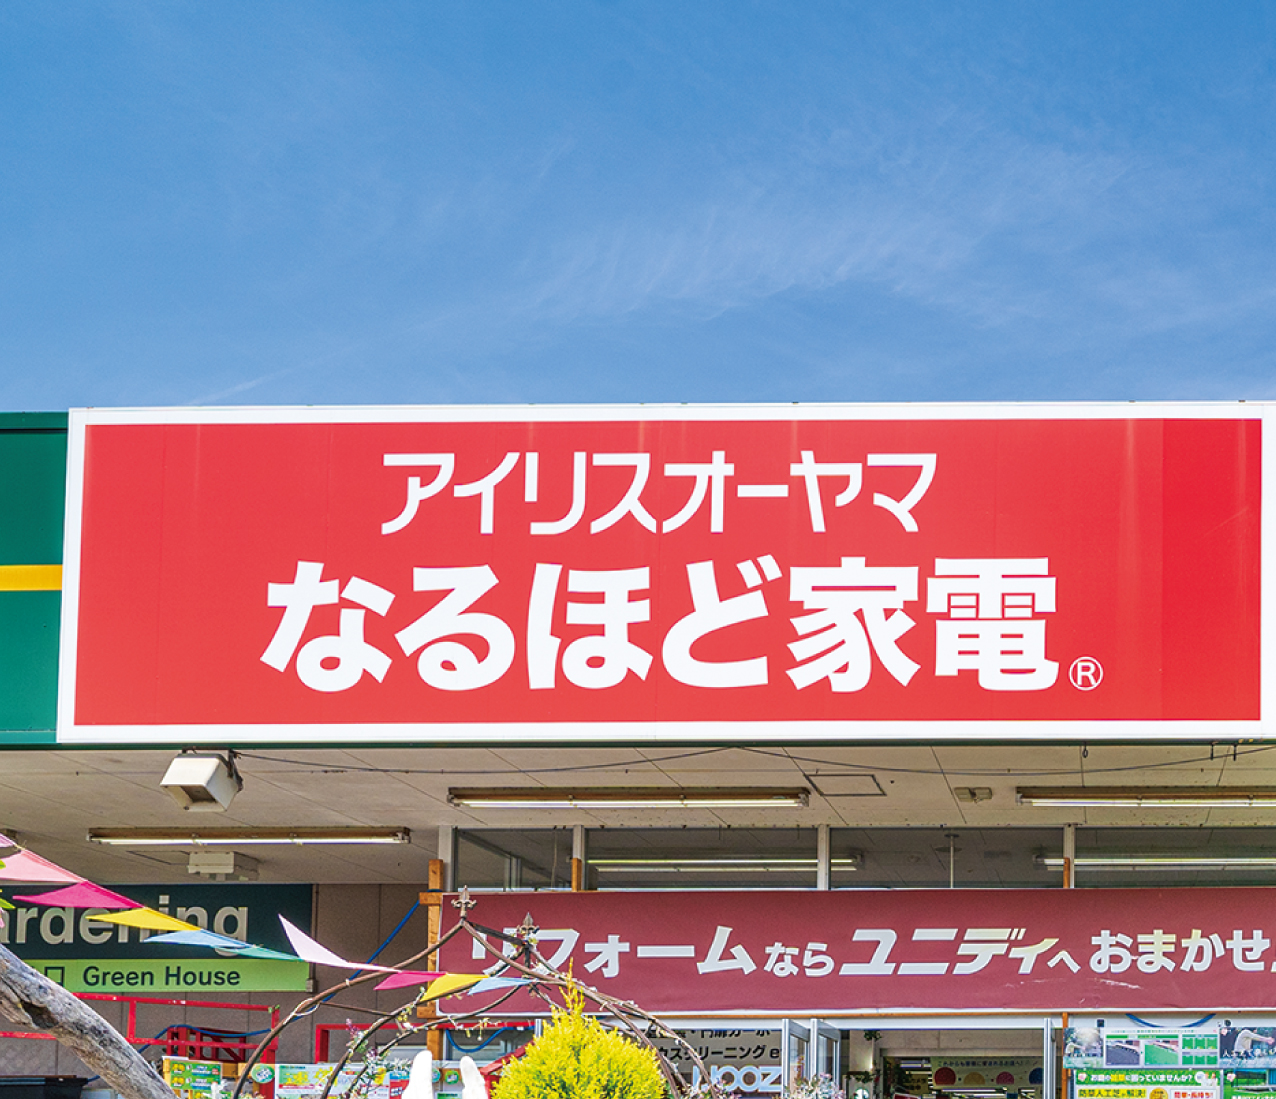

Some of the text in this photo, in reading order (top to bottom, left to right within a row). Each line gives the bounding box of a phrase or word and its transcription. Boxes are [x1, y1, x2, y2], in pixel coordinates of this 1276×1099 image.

[381, 450, 937, 535] アイリスオーヤマ
[83, 965, 240, 986] Green House
